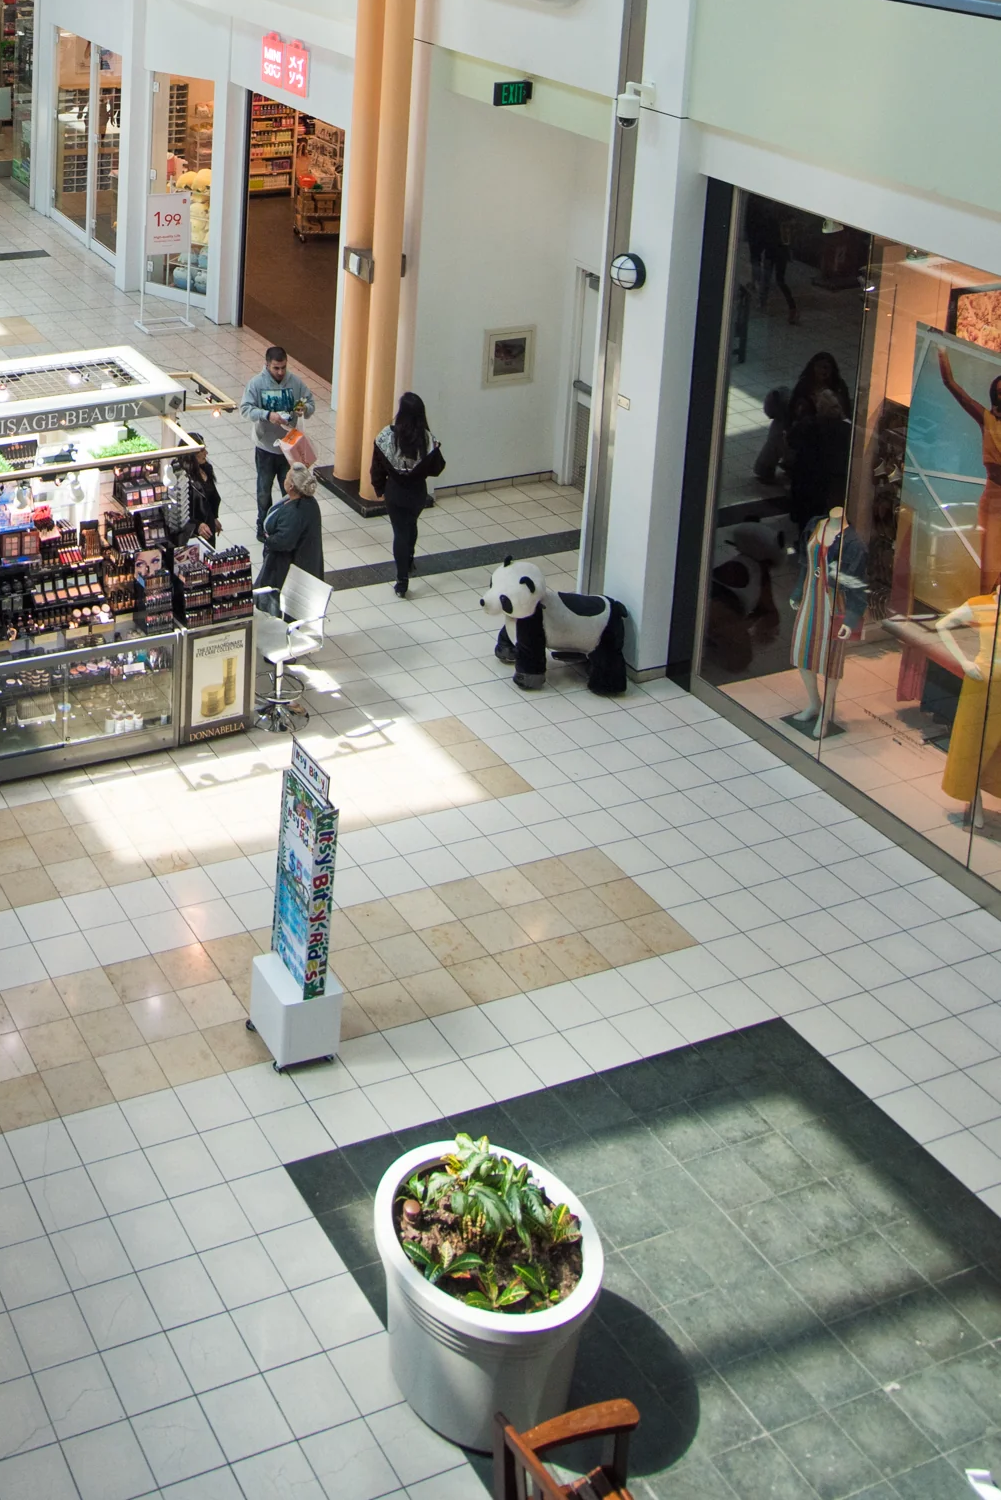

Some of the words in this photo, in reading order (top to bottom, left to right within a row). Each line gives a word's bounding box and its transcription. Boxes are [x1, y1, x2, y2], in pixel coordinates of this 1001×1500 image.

[264, 46, 281, 64] MINI
[501, 83, 524, 105] EXIT
[154, 211, 181, 227] 1.99
[66, 401, 143, 426] BEAUTY
[189, 722, 245, 742] DONNABELLA
[315, 830, 335, 865] Itsy
[309, 873, 329, 923] Bitsy
[305, 932, 323, 981] Rides
